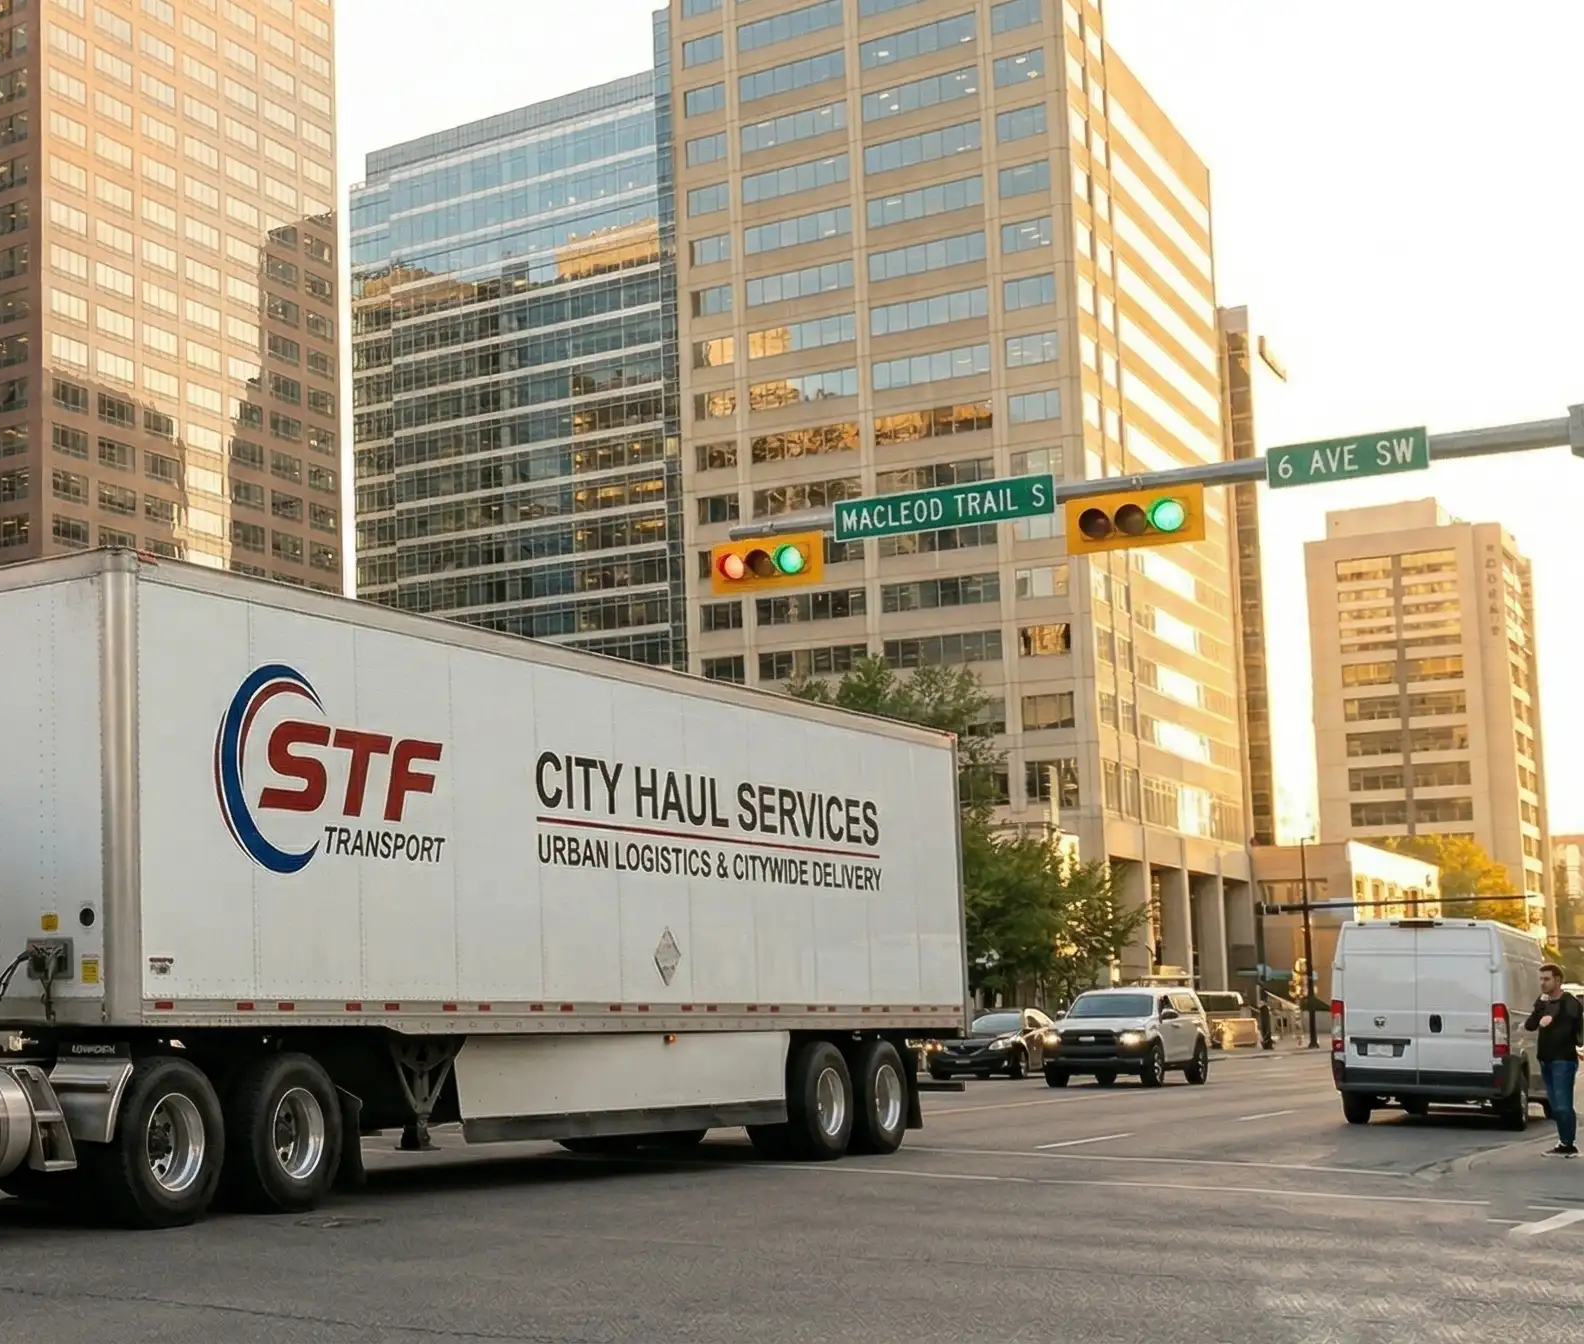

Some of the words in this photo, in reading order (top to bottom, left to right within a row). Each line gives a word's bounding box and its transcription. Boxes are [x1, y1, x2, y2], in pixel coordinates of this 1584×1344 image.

[1278, 455, 1293, 479] 6
[1310, 444, 1359, 475] AVE
[1376, 437, 1414, 466] SW
[842, 498, 942, 532] MACLEOD
[954, 488, 1018, 517] TRAIL
[1032, 484, 1045, 507] S
[258, 720, 443, 822] STF
[536, 751, 623, 815] CITY
[635, 766, 729, 828] HAUL
[737, 782, 880, 847] SERVICES
[324, 826, 445, 863] TRANSPORT
[538, 833, 609, 869] URBAN
[615, 841, 712, 878] LOGISTICS
[716, 852, 729, 879] &
[733, 853, 809, 886] CITYWIDE
[813, 861, 882, 892] DELIVERY
